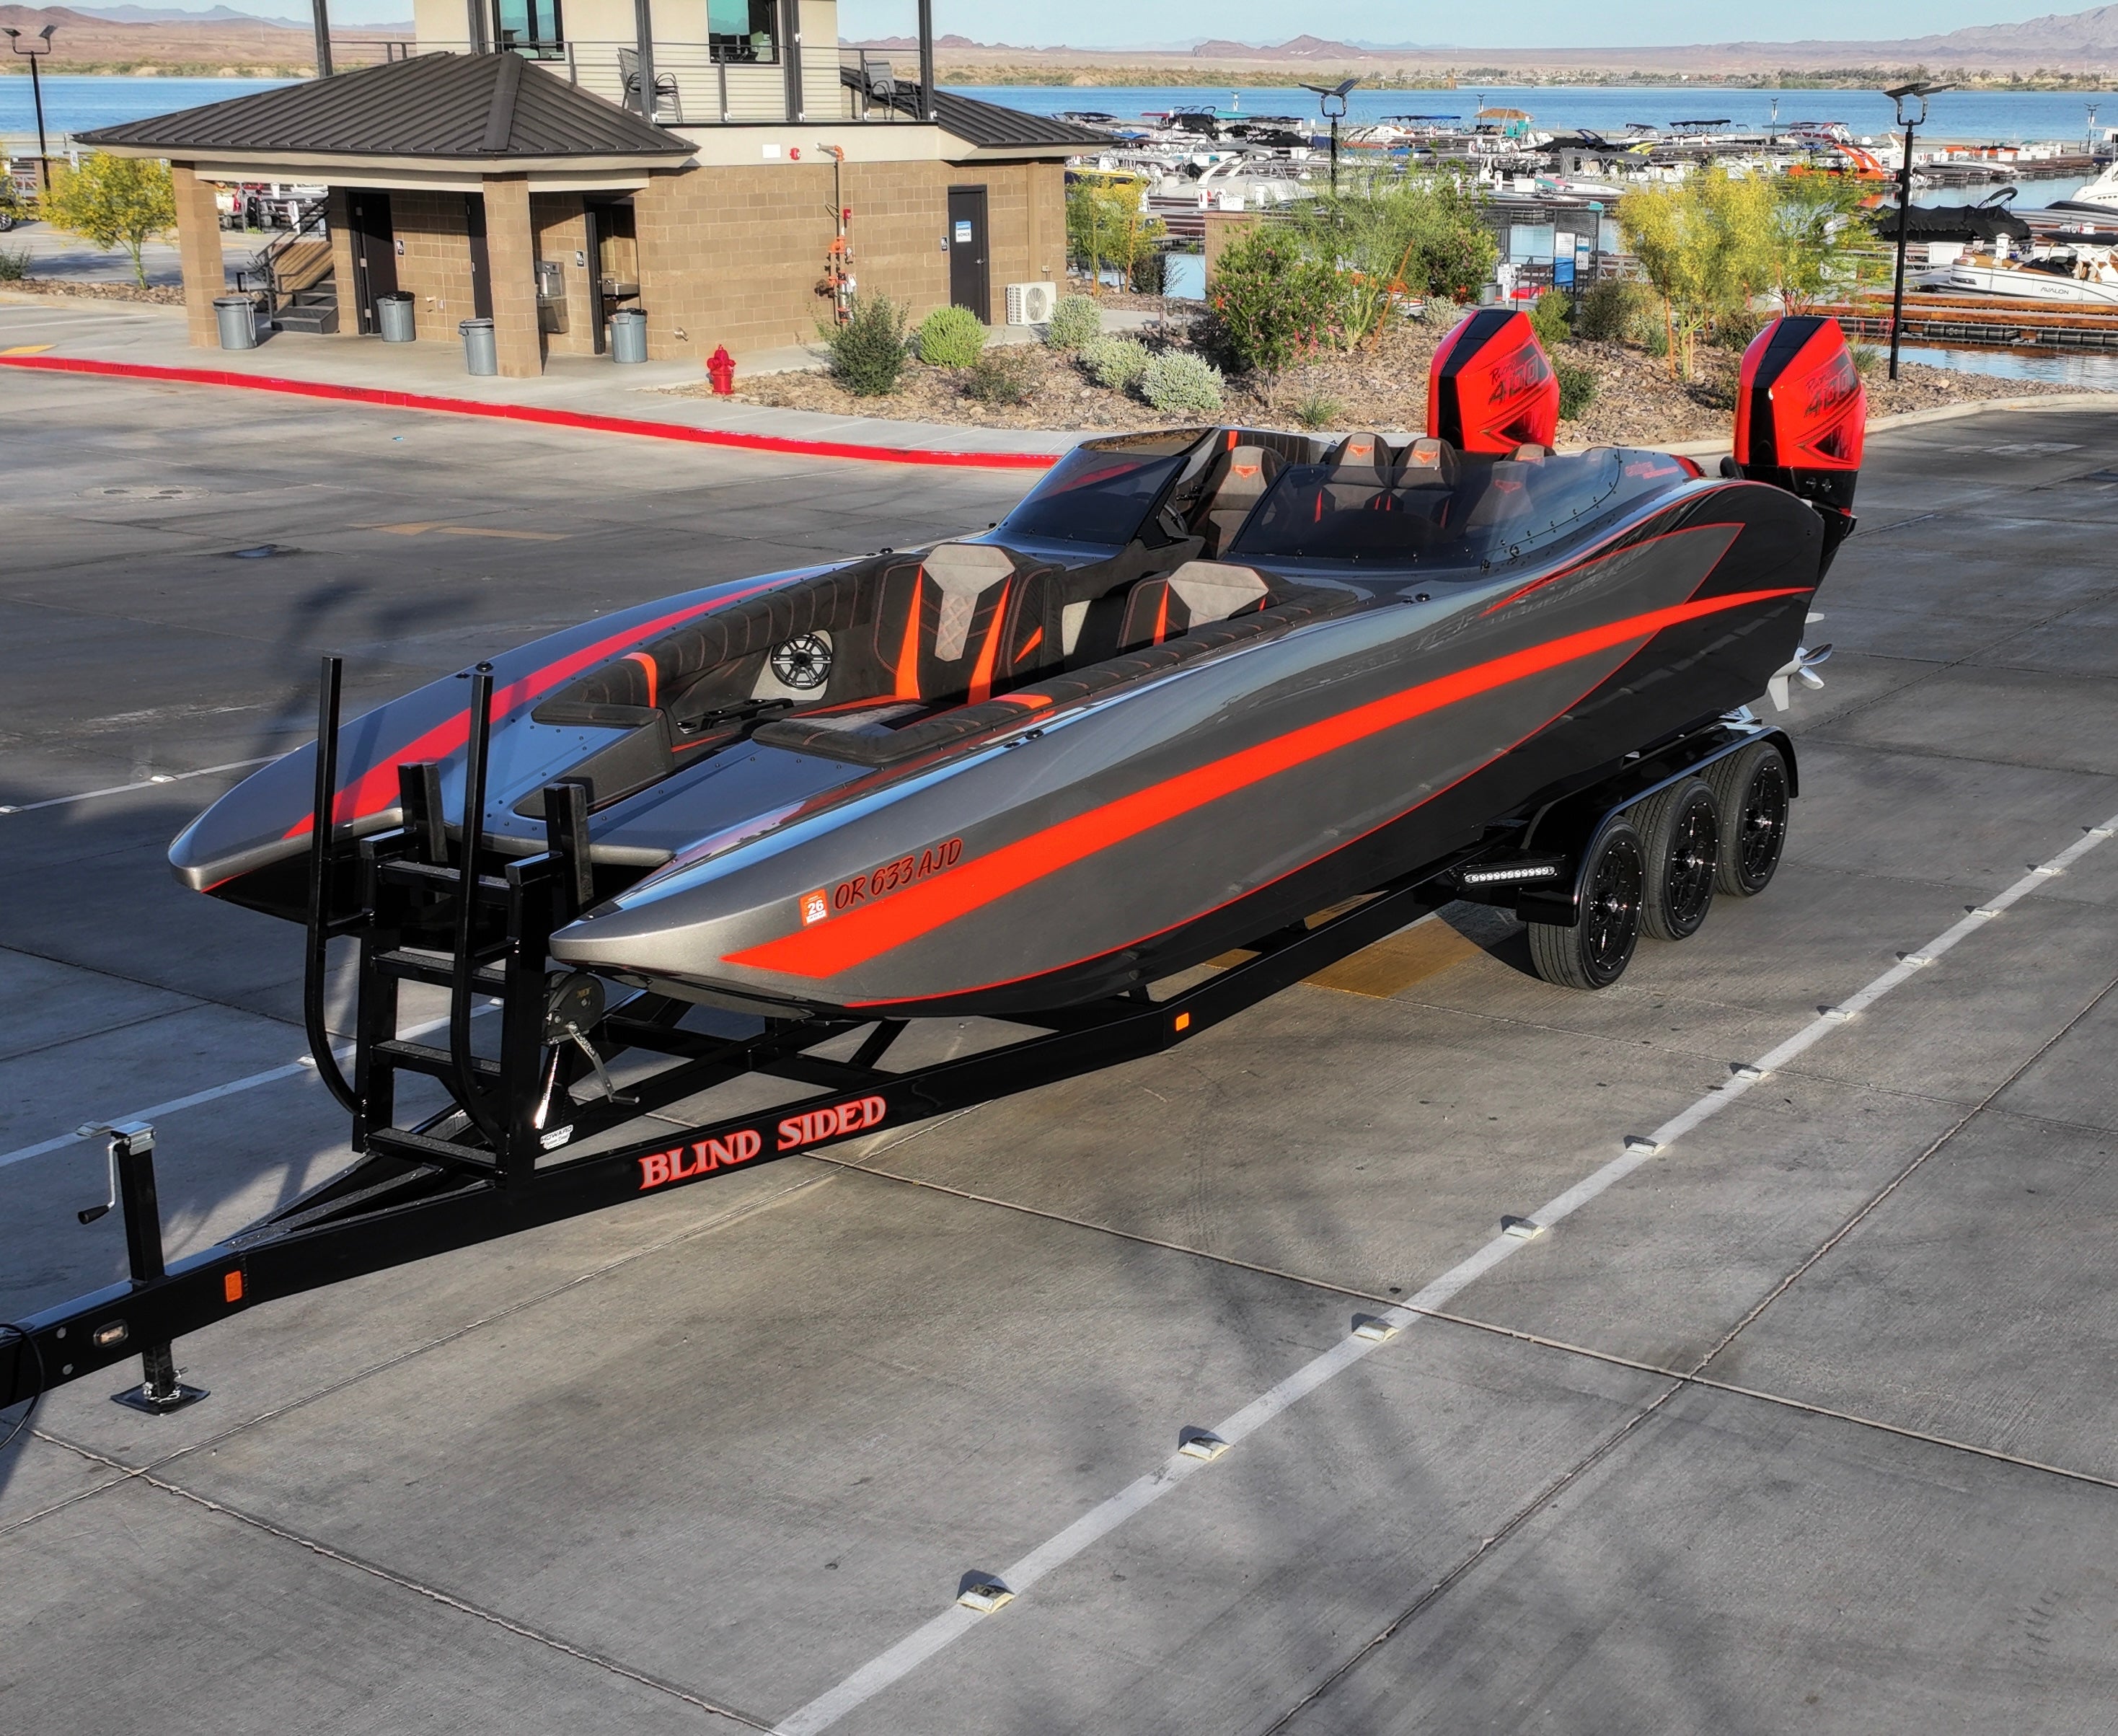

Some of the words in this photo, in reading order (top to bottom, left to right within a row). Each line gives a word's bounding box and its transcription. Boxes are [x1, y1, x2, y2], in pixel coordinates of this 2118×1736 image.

[2040, 286, 2070, 295] AVALON
[1488, 353, 1539, 405] 400
[835, 876, 865, 909] OR
[871, 857, 914, 895] 633
[917, 839, 962, 878] AJD
[808, 899, 824, 915] 26
[541, 1126, 572, 1141] HOWARD
[638, 1129, 762, 1190] BLIND
[777, 1096, 887, 1151] SIDED
